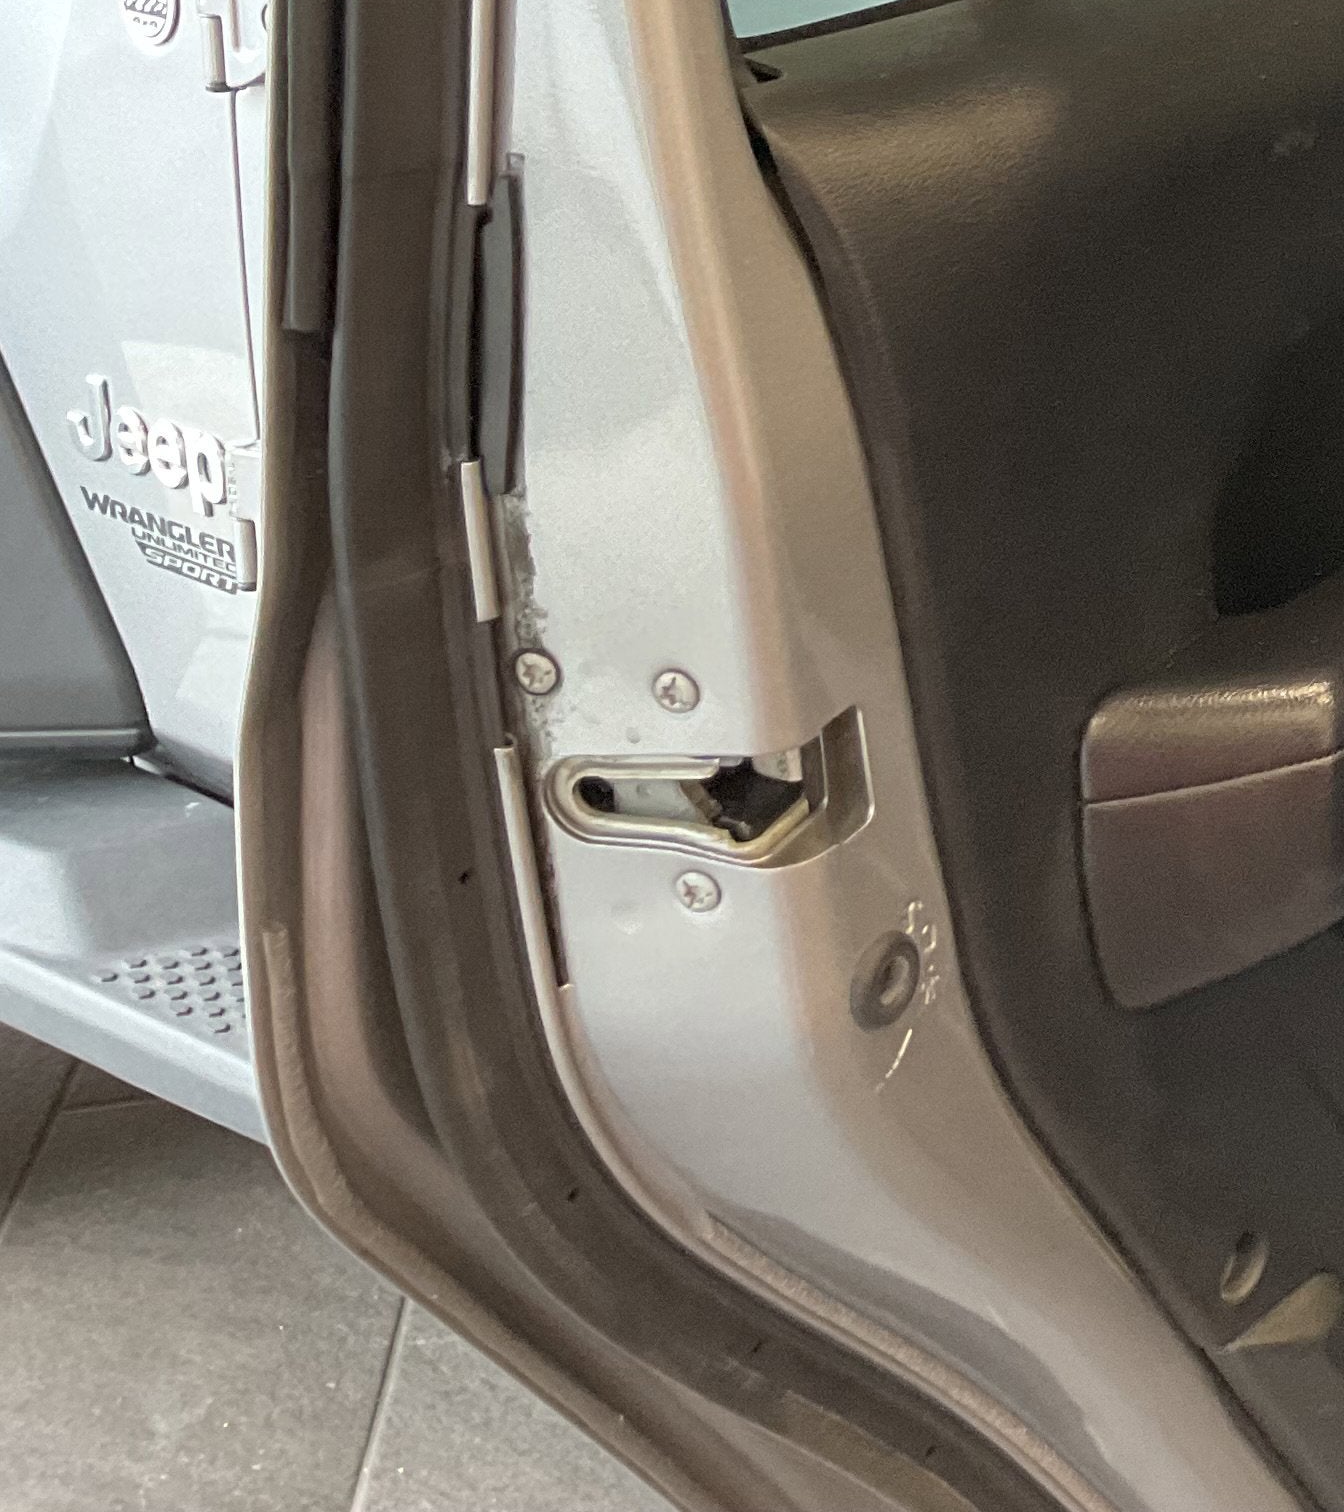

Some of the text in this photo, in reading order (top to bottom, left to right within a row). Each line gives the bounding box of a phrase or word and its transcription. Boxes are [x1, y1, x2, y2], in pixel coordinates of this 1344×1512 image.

[67, 374, 227, 517] Jeep
[80, 485, 236, 564] WRANGLER
[144, 546, 240, 594] SPORT
